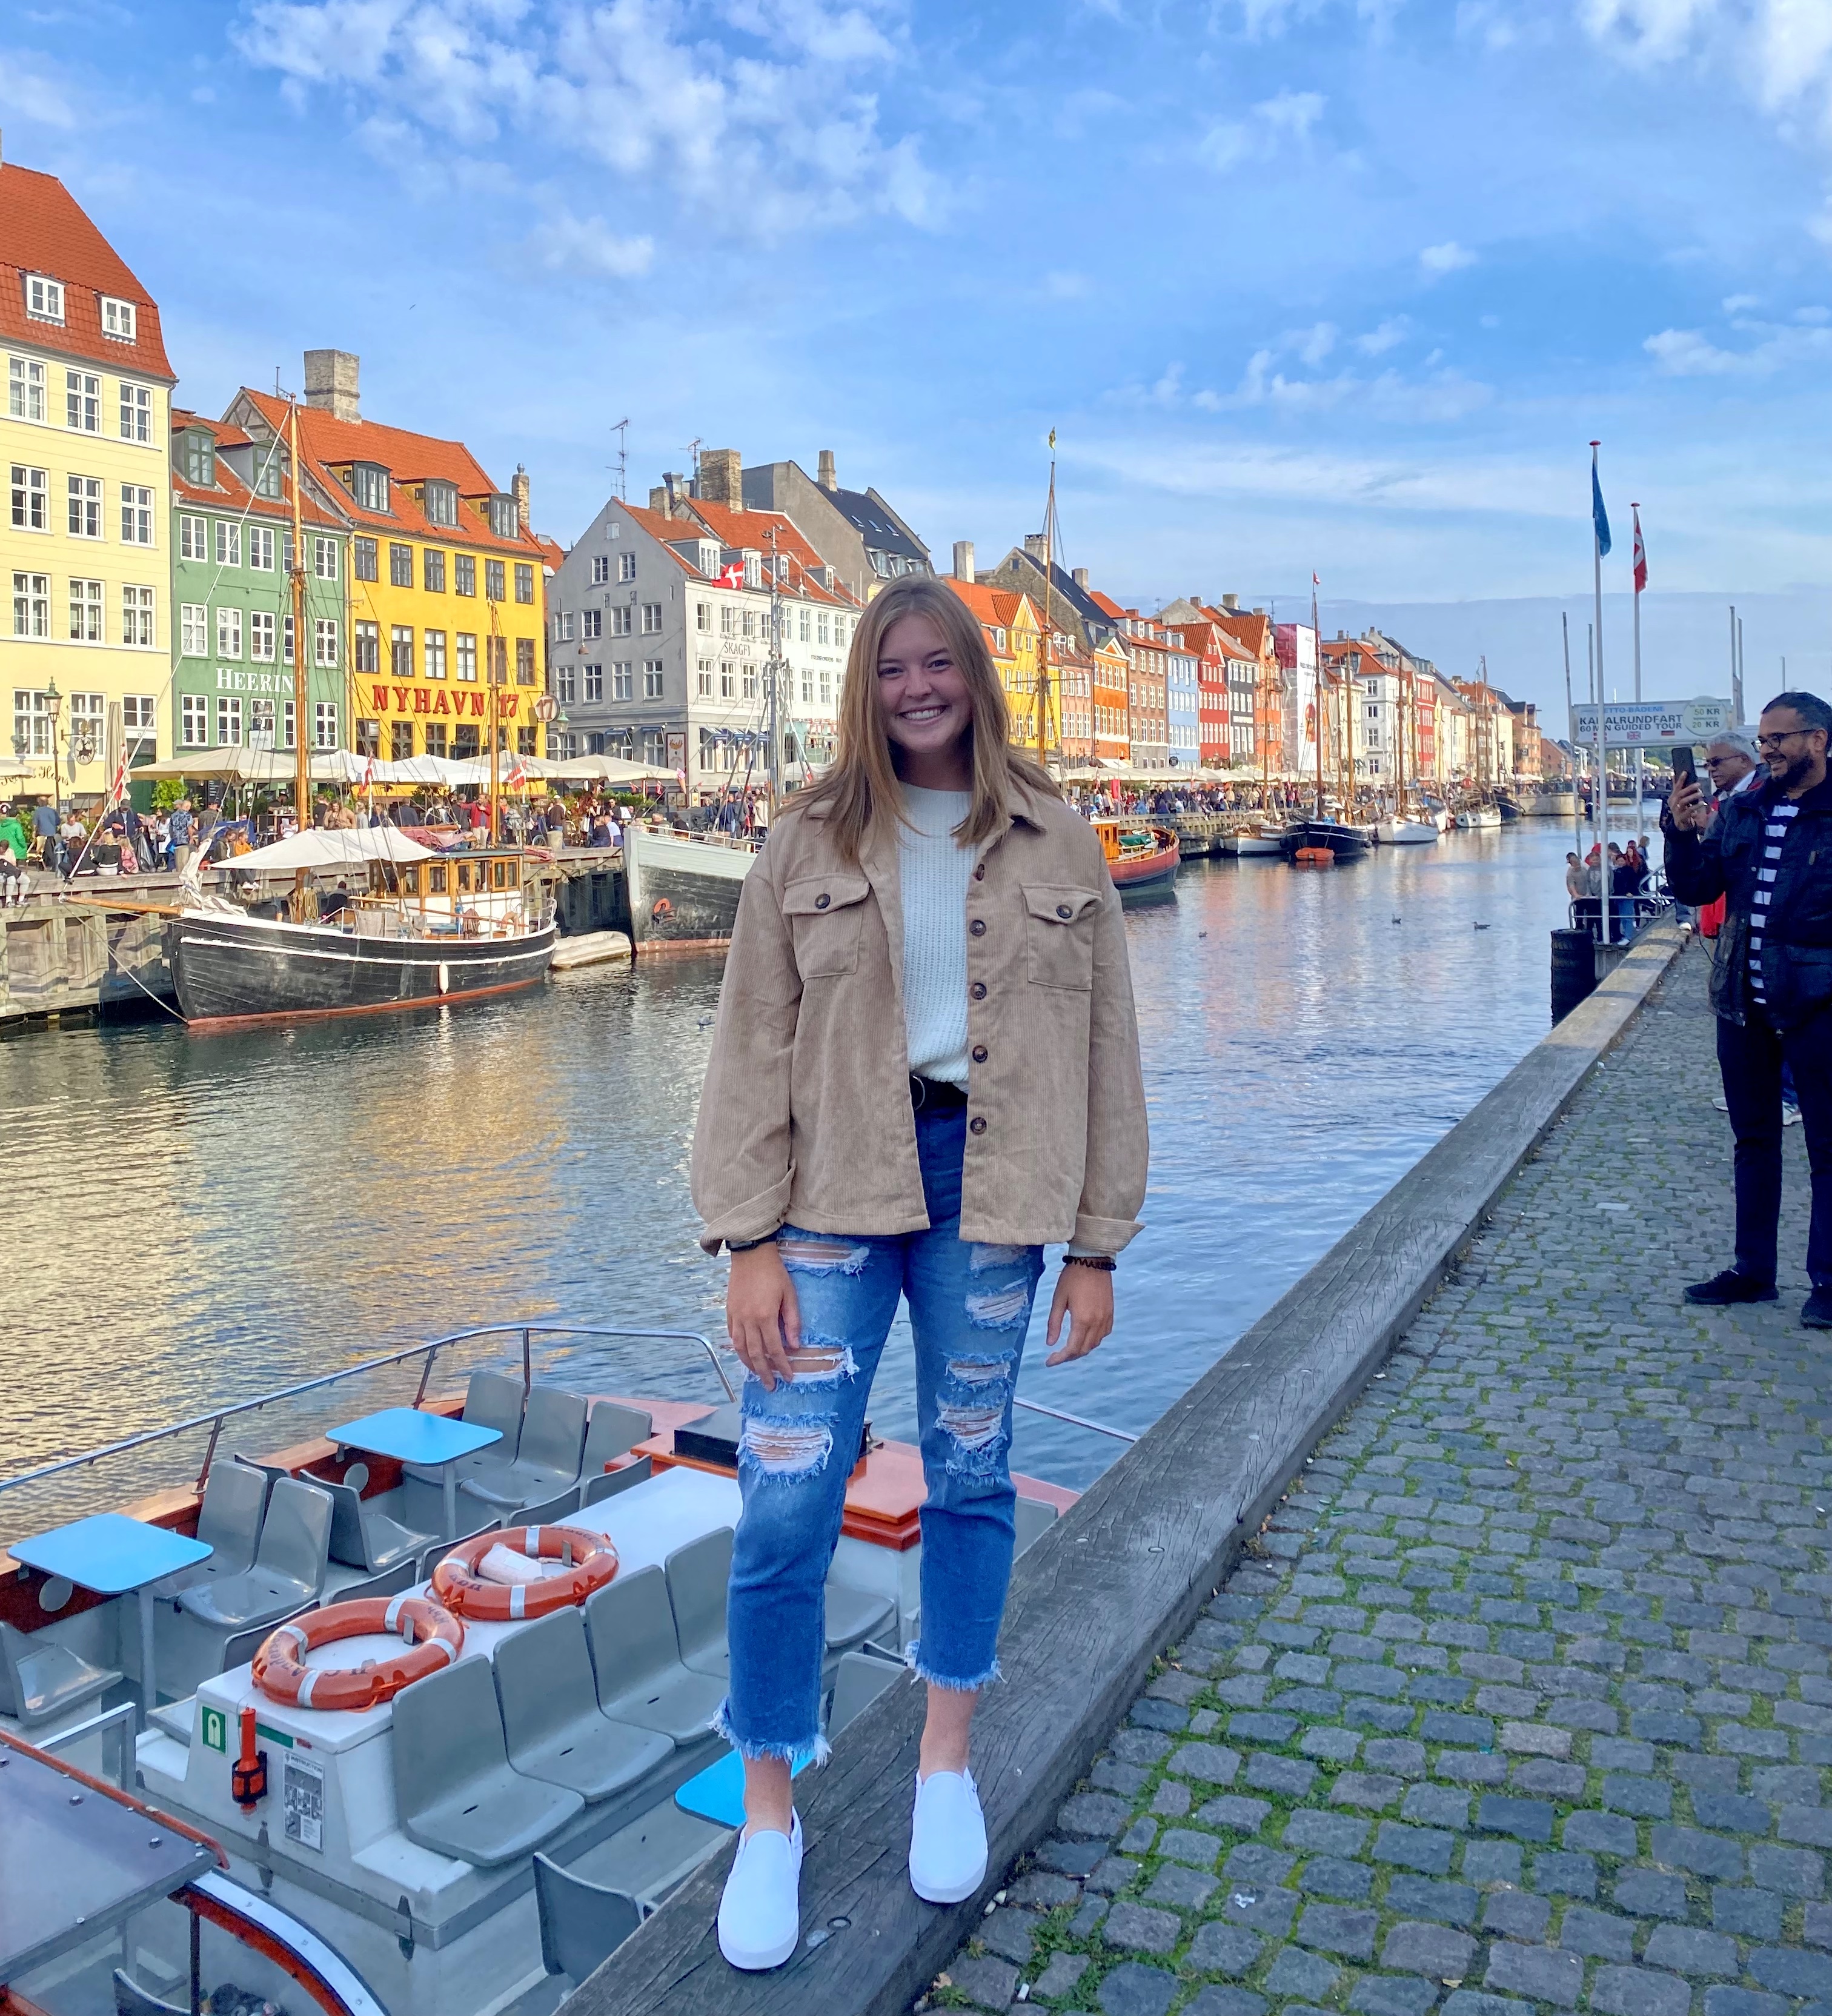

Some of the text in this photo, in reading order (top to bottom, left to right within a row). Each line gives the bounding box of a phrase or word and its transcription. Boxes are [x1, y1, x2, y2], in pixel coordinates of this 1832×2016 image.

[215, 667, 308, 694] HEERIN
[372, 684, 520, 718] NYHAVN 17
[536, 698, 554, 721] 17
[1579, 714, 1683, 725] KAALRUNDFART
